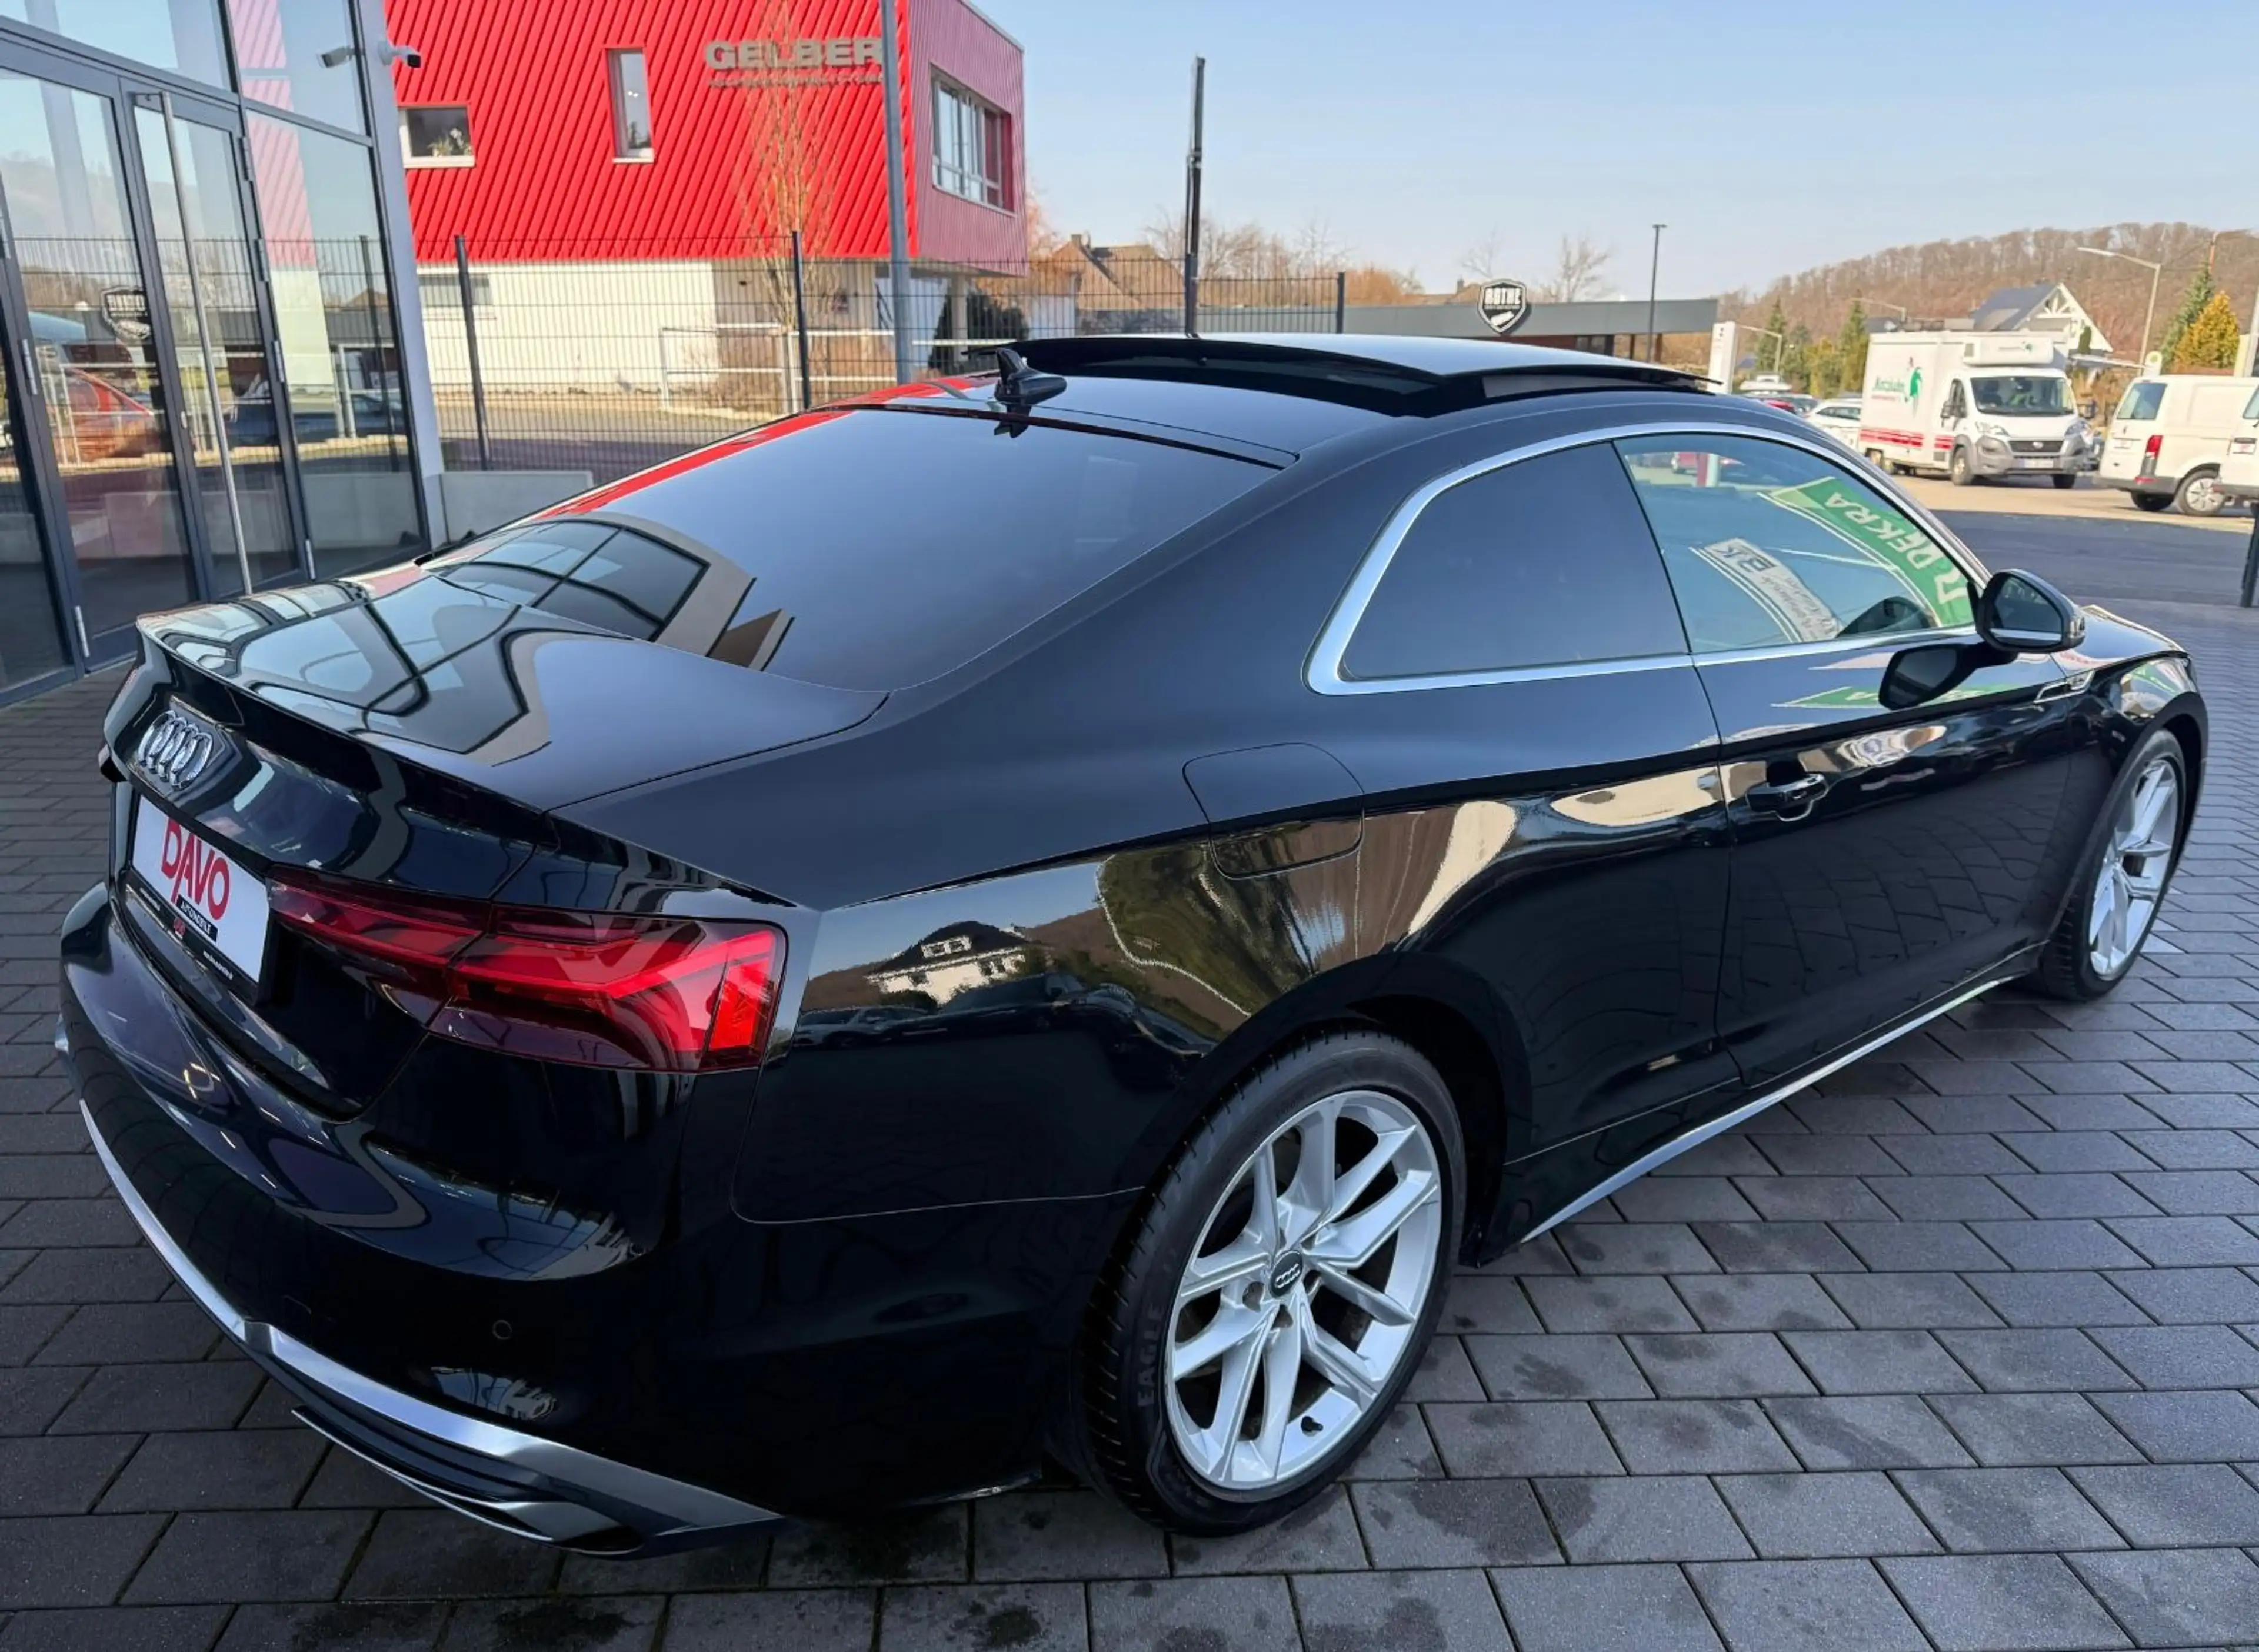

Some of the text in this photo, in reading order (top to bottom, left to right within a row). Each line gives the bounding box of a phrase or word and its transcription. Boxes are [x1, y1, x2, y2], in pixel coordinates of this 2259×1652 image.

[706, 38, 882, 69] GELBER
[1825, 492, 1944, 569] DEKRA
[161, 819, 229, 920] DAVO
[1137, 1303, 1165, 1407] EAGLE
